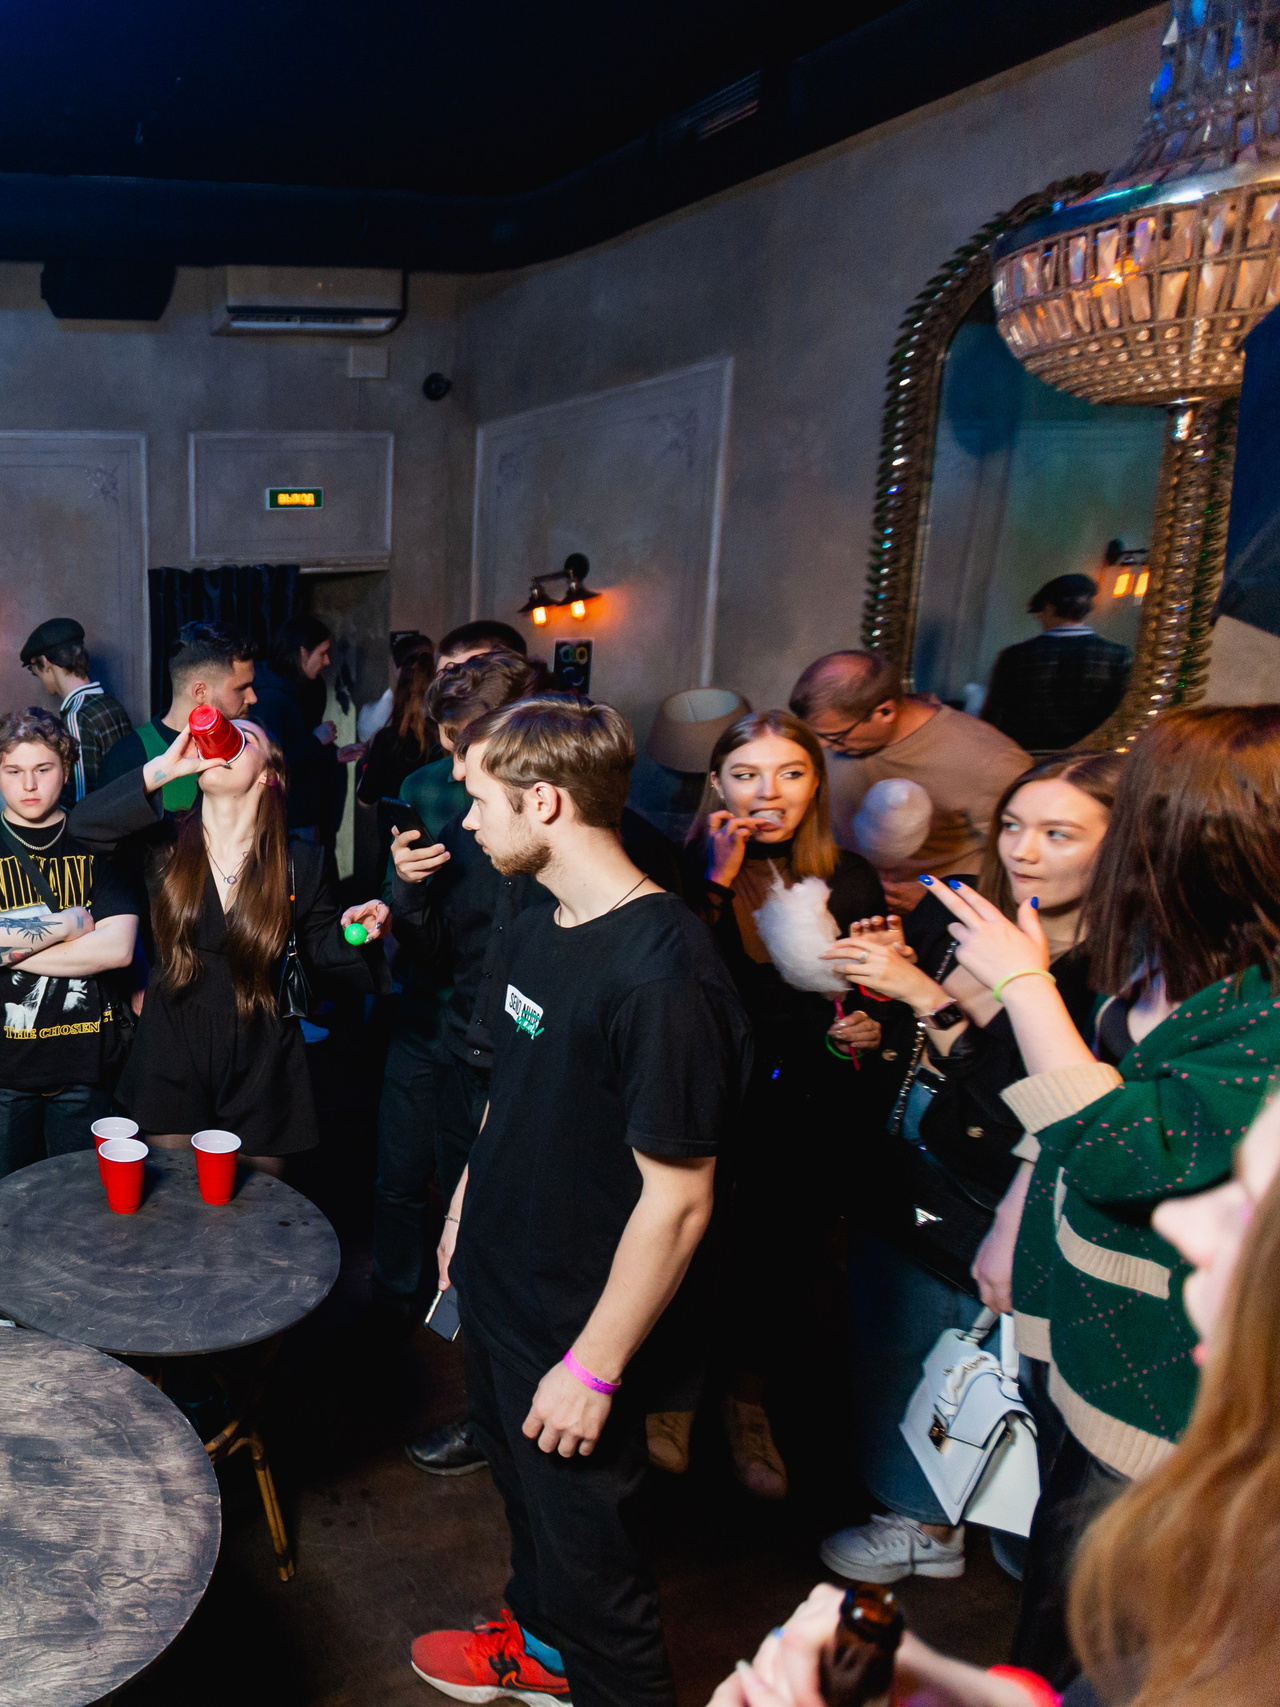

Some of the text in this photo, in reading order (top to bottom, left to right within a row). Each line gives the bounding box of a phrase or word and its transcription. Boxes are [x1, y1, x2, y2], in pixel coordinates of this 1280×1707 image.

[277, 492, 316, 507] ВЫХОД
[3, 1021, 101, 1040] THE CHOSEN
